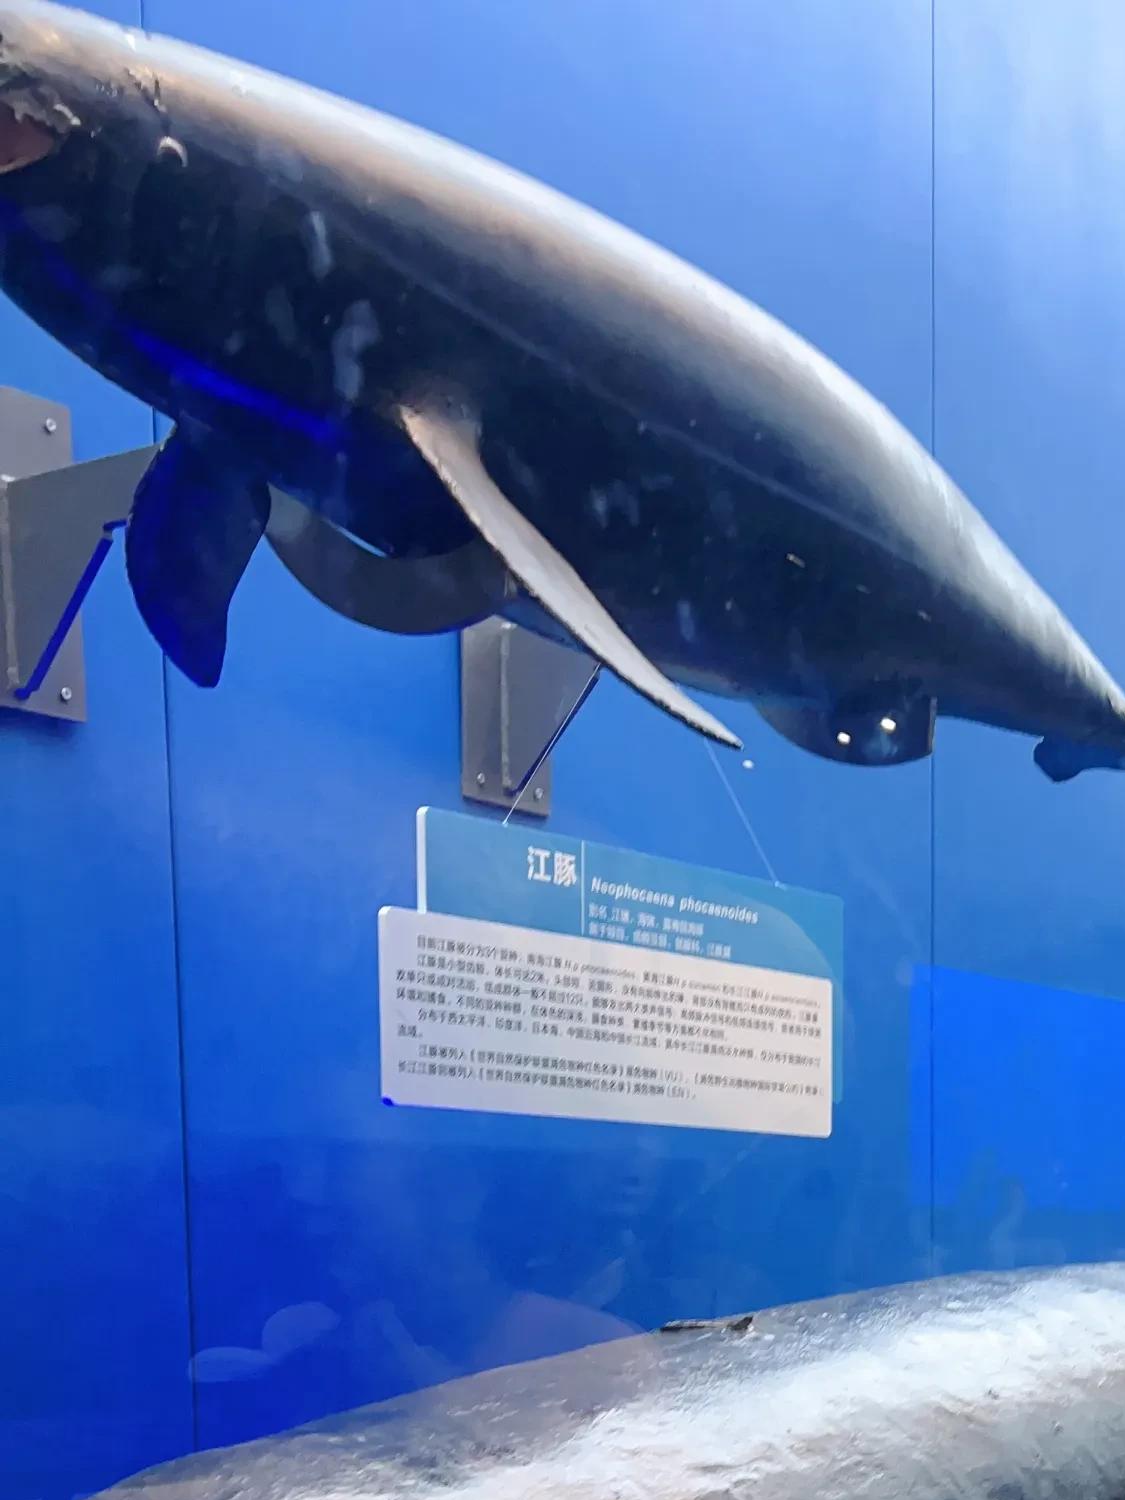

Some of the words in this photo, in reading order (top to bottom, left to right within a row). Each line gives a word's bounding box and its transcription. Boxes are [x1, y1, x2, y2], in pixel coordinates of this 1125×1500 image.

[527, 846, 577, 887] 江豚
[591, 877, 675, 908] Neophocaena
[679, 896, 759, 925] phocaenoides
